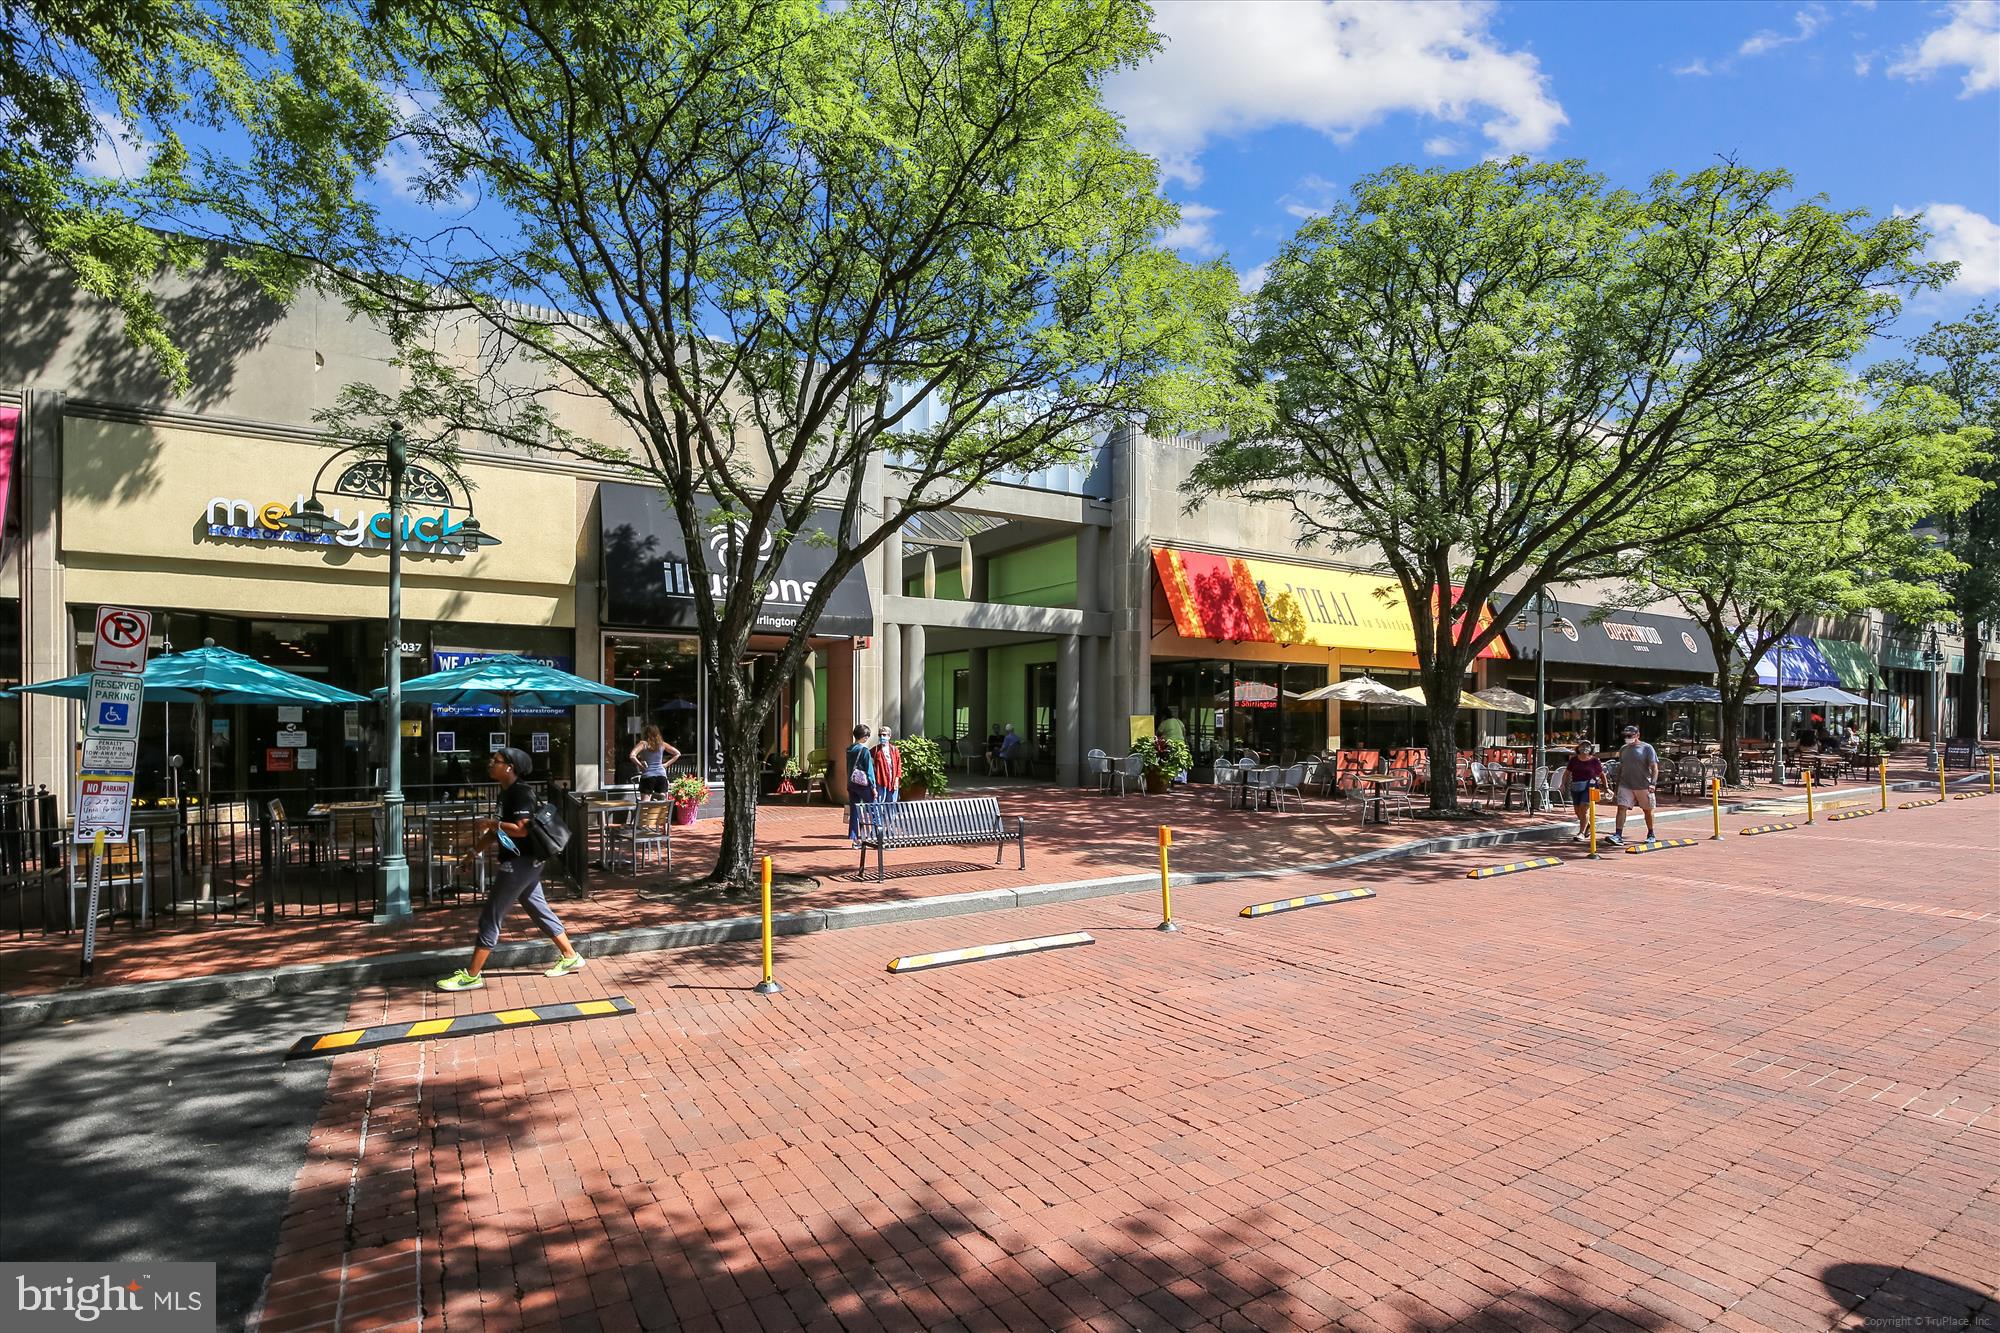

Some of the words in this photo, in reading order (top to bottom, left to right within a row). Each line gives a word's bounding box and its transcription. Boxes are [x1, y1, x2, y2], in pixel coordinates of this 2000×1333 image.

[208, 524, 260, 539] HOUSE
[262, 529, 281, 539] OF
[756, 614, 797, 628] irlington
[1602, 621, 1663, 645] COPPERWOOD
[94, 679, 140, 691] RESERVED
[95, 690, 136, 701] PARKING
[86, 783, 98, 793] NO
